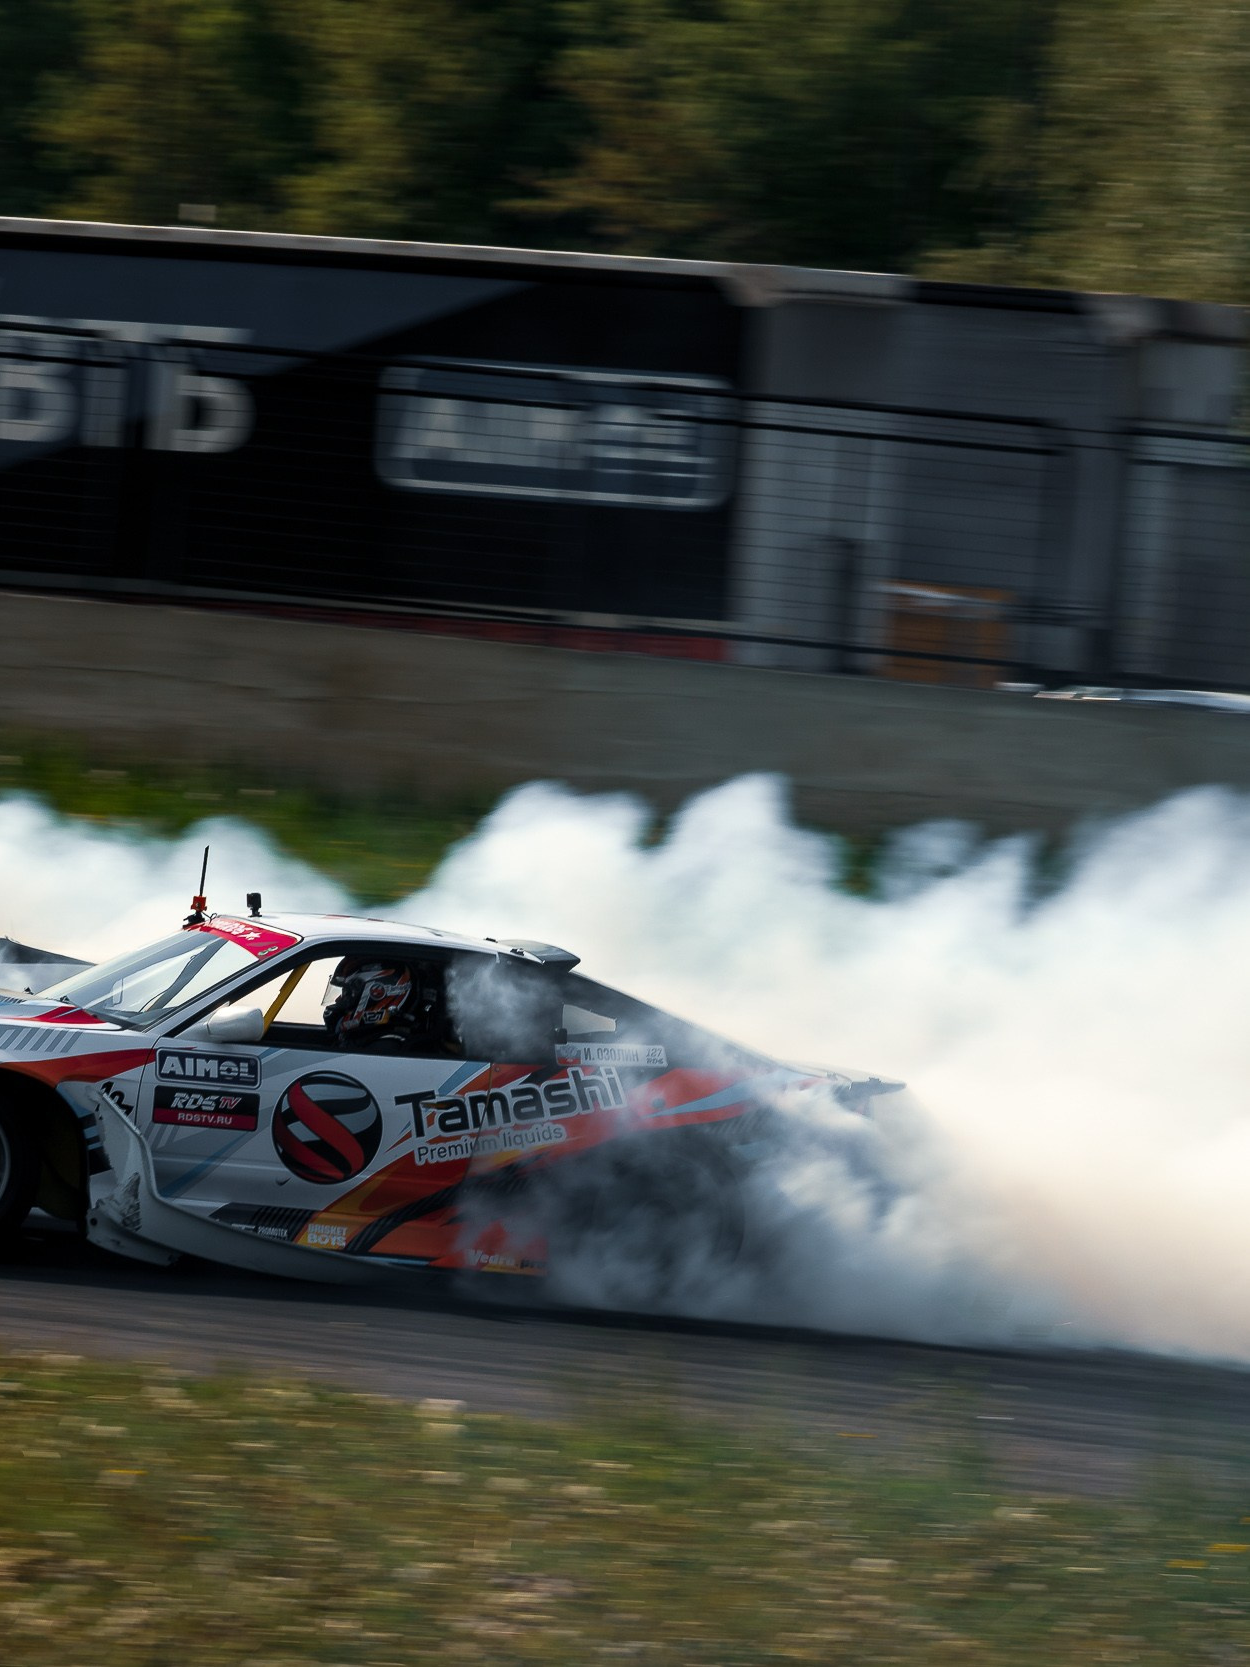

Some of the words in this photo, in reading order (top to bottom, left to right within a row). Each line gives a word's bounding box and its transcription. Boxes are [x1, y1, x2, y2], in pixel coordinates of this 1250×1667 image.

[583, 1047, 594, 1061] И.
[597, 1047, 639, 1062] ОЗОЛИН
[645, 1048, 662, 1057] 127
[160, 1056, 255, 1081] AIMOL
[170, 1092, 218, 1111] RDS
[218, 1096, 241, 1110] TV
[394, 1067, 626, 1138] Tamashi
[177, 1112, 233, 1125] RDSTV.RU
[418, 1138, 497, 1162] Premium
[503, 1126, 563, 1152] liquids
[307, 1233, 347, 1247] BOYS
